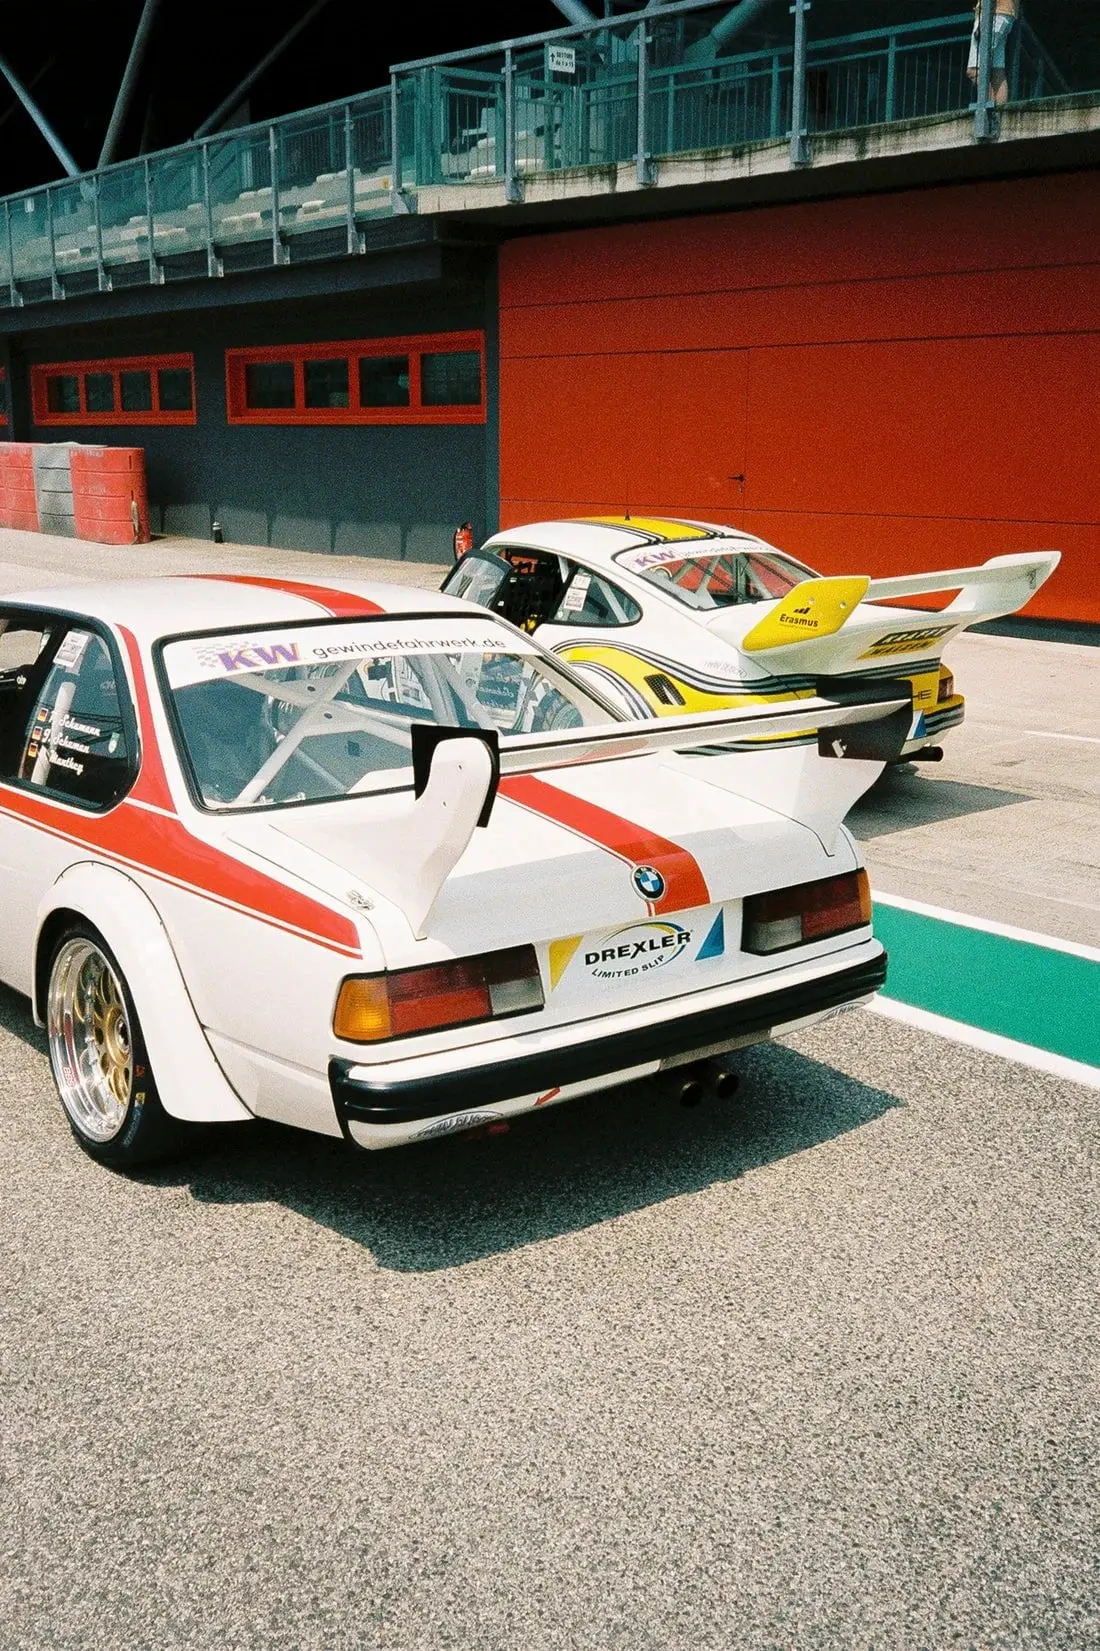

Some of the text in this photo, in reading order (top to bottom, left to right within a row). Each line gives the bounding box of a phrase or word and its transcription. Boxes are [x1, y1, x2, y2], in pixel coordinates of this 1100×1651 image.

[634, 550, 676, 567] KW
[779, 613, 819, 627] Erasmus
[216, 638, 505, 671] KW gewindefahrwerk.de
[634, 866, 658, 879] BMW
[585, 931, 691, 966] DREXLER
[591, 954, 665, 979] LIMITED SLIP
